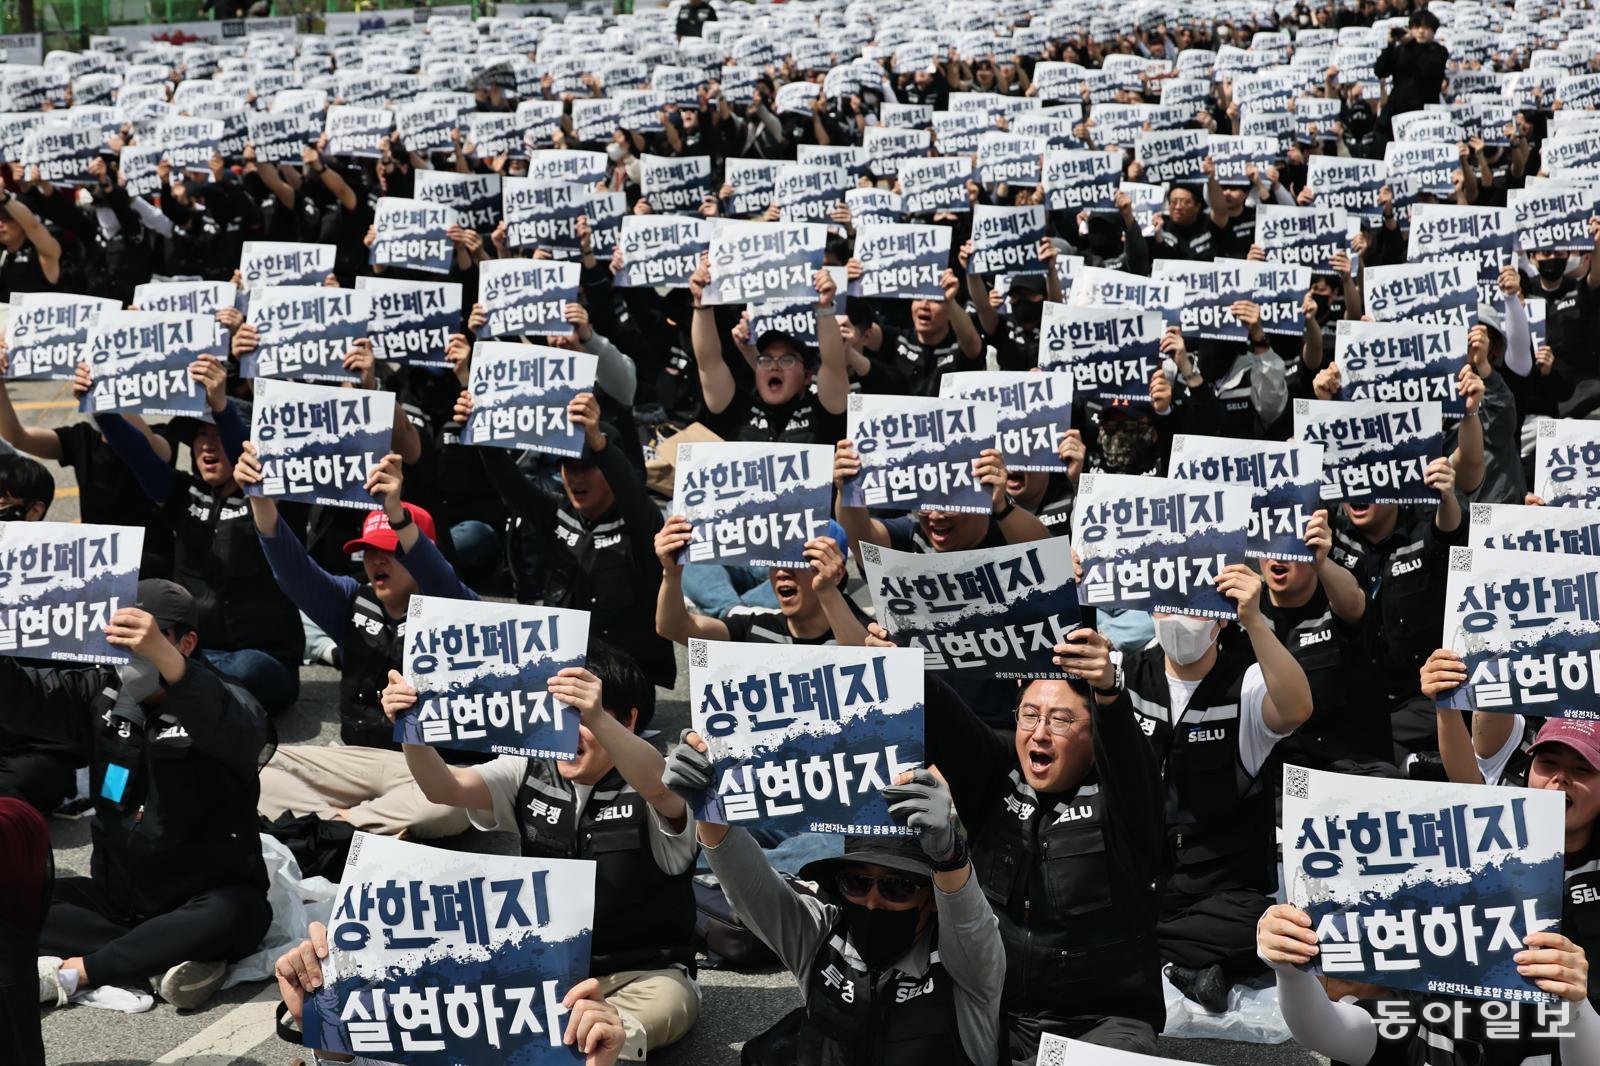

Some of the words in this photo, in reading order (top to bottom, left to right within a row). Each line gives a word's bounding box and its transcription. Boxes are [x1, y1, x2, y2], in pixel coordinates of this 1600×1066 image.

[1141, 132, 1199, 159] 상한폐지
[1392, 146, 1450, 168] 상한폐지
[534, 155, 594, 179] 상한폐지
[645, 164, 700, 187] 상한폐지
[776, 169, 839, 197] 상한폐지
[903, 161, 961, 188] 상한폐지
[1048, 154, 1112, 183] 상한폐지
[1312, 163, 1377, 188] 상한폐지
[505, 185, 571, 214] 상한폐지
[1515, 192, 1584, 223] 상한폐지
[377, 207, 446, 232] 상한폐지
[456, 208, 499, 229] 하자
[506, 215, 577, 247] 실현하자
[975, 210, 1036, 242] 상한폐지
[1262, 213, 1335, 239] 상한폐지
[1416, 212, 1500, 244] 상한폐지
[1518, 220, 1591, 248] 실현하자
[375, 238, 452, 264] 실현하자
[624, 222, 699, 252] 상한폐지
[717, 227, 809, 266] 상한폐지
[859, 229, 937, 262] 상한폐지
[246, 250, 321, 282] 상한폐지
[628, 252, 700, 285] 실현하자
[972, 240, 1041, 273] 실현하자
[485, 266, 564, 301] 상한폐지
[719, 263, 818, 301] 실현하자
[860, 264, 941, 296] 실현하자
[1370, 267, 1463, 310] 상한폐지
[256, 294, 351, 335] 상한폐지
[489, 299, 567, 337] 실현하자
[1180, 304, 1242, 331] 현하자
[92, 319, 194, 365] 상한폐지
[370, 327, 450, 360] 실현하자
[1047, 315, 1144, 350] 상한폐지
[255, 336, 354, 377] 실현하자
[1344, 330, 1450, 370] 상한폐지
[92, 369, 197, 410] 실현하자
[474, 357, 575, 396] 상한폐지
[257, 396, 371, 441] 상한폐지
[472, 404, 575, 441] 실현하자
[1226, 401, 1248, 412] SELU
[856, 406, 976, 454] 상한폐지
[998, 424, 1064, 457] 하자
[1304, 407, 1421, 450] 상한폐지
[262, 452, 380, 496] 실현하자
[682, 450, 810, 506] 상한폐지
[1319, 455, 1428, 501] 실현하자
[1081, 491, 1224, 543] 상한폐지
[1248, 504, 1312, 541] 하자
[689, 509, 828, 562] 실현하자
[880, 548, 1045, 616] 상한폐지
[1083, 554, 1227, 603] 실현하자
[1391, 559, 1422, 577] SELU
[352, 611, 384, 636] 투쟁
[1154, 604, 1201, 617] 삼성전자노동조합
[1202, 609, 1238, 621] 공동투쟁본부
[410, 615, 559, 675] 상한폐지
[908, 614, 1078, 671] 실현하자
[1300, 629, 1332, 647] SELU
[700, 655, 889, 737] 상한폐지
[418, 690, 572, 743] 실현하자
[1188, 728, 1225, 743] SELU
[491, 744, 537, 757] 삼성전자노동조합
[538, 749, 575, 761] 공동투쟁본부
[718, 745, 918, 821] 실현하자
[526, 798, 561, 824] 투쟁
[595, 804, 633, 822] SELU
[810, 822, 871, 835] 삼성전자노동조합
[873, 825, 922, 836] 공동투쟁본부
[1295, 798, 1529, 878] 상한폐지
[334, 870, 551, 951] 상한폐지
[1316, 898, 1558, 973] 실현하자
[895, 977, 934, 1003] SELU
[1428, 981, 1502, 998] 삼성전자노동조합
[1503, 988, 1559, 1003] 공동투쟁본부
[340, 980, 571, 1053] 실현하자
